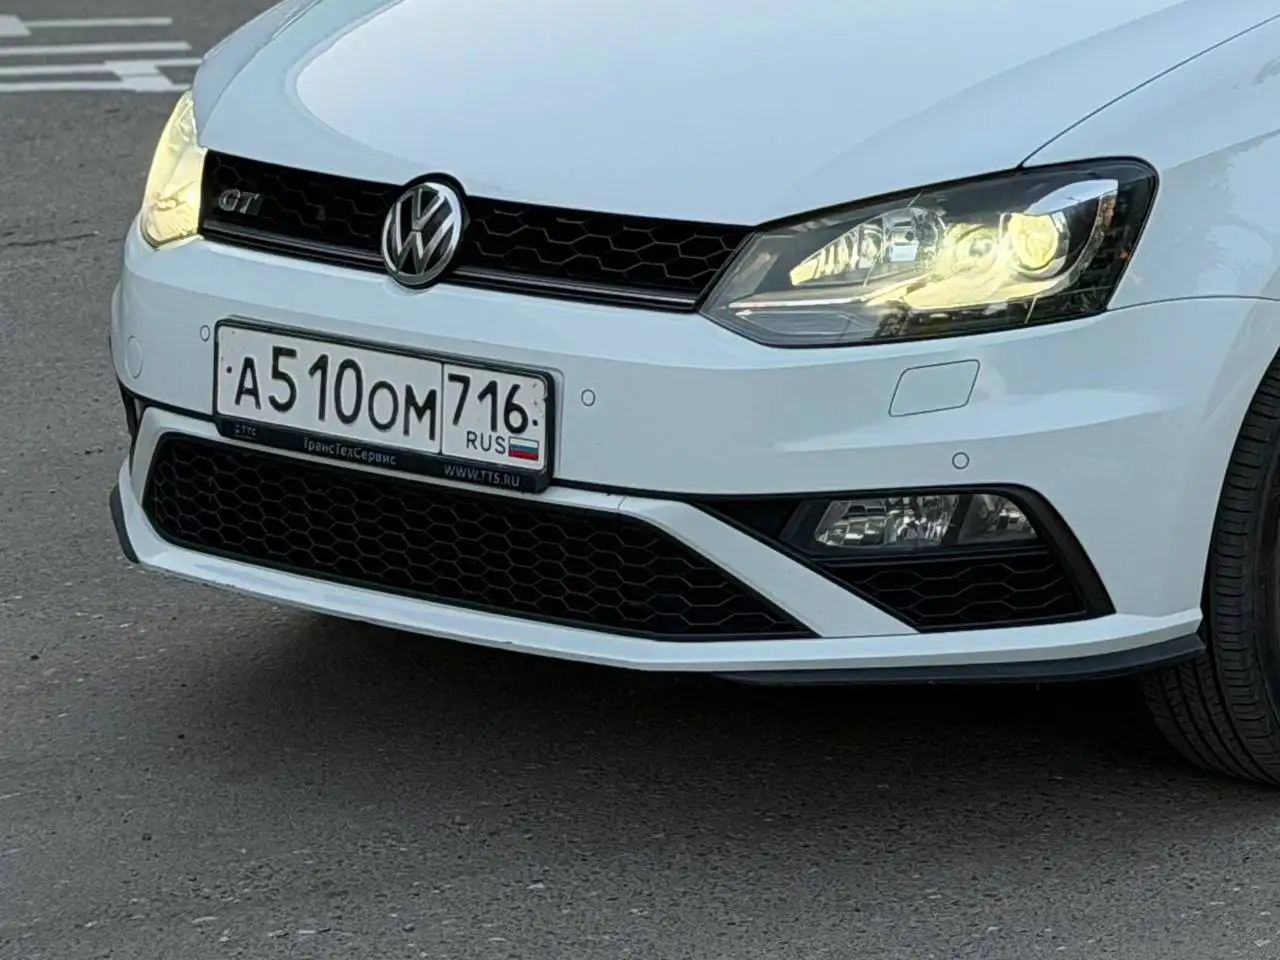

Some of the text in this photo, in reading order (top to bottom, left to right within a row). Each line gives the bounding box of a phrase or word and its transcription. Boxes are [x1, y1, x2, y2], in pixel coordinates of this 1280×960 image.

[218, 188, 262, 215] GT
[447, 372, 529, 434] 716
[303, 437, 397, 466] ТрансТехСервис
[466, 430, 506, 455] RUS
[444, 464, 520, 487] WWW.TTS.RU
